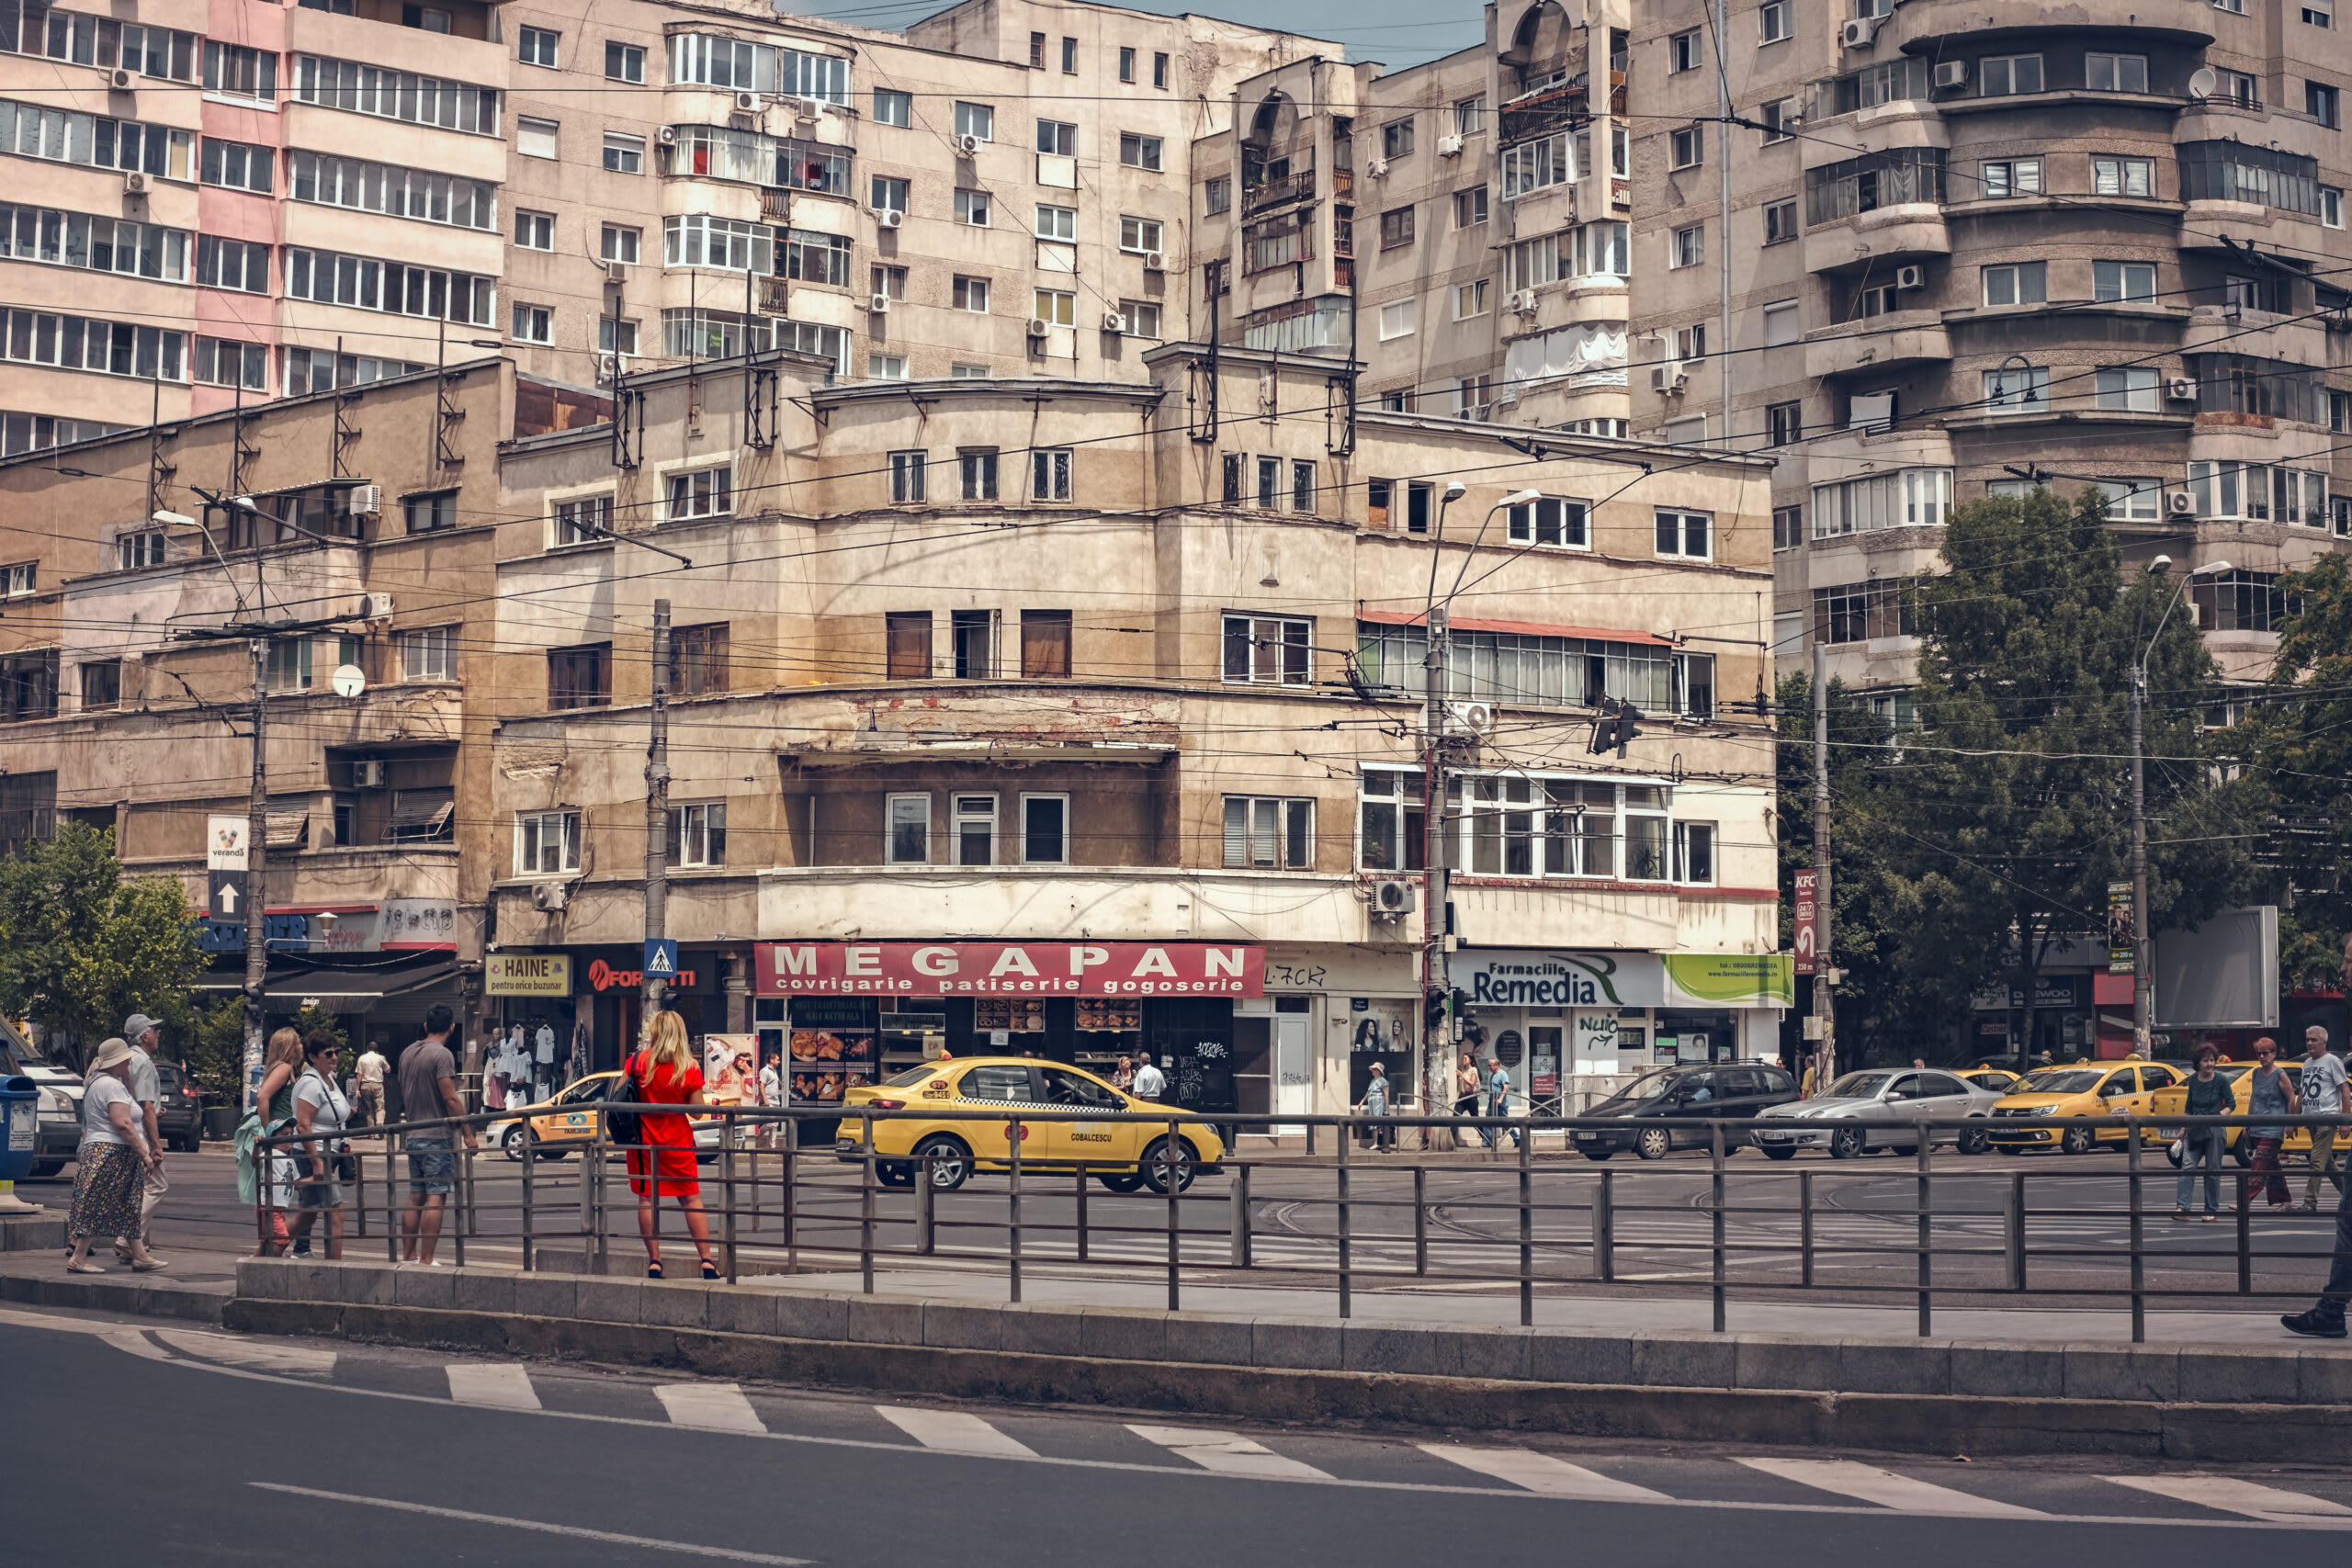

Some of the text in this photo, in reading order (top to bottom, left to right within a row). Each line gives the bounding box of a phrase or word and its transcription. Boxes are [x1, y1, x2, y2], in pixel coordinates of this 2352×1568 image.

[1795, 875, 1815, 888] KFC
[505, 959, 548, 976] HAINE
[775, 946, 1244, 976] MEGAPAN
[1489, 963, 1566, 976] Farmaciile
[492, 979, 561, 991] pentru orice buzunar
[776, 977, 1243, 994] covrigarie patiserie gogoserie
[1474, 972, 1597, 1004] Remedia
[2302, 1074, 2322, 1099] 56
[1071, 1133, 1112, 1142] COBALCESCU
